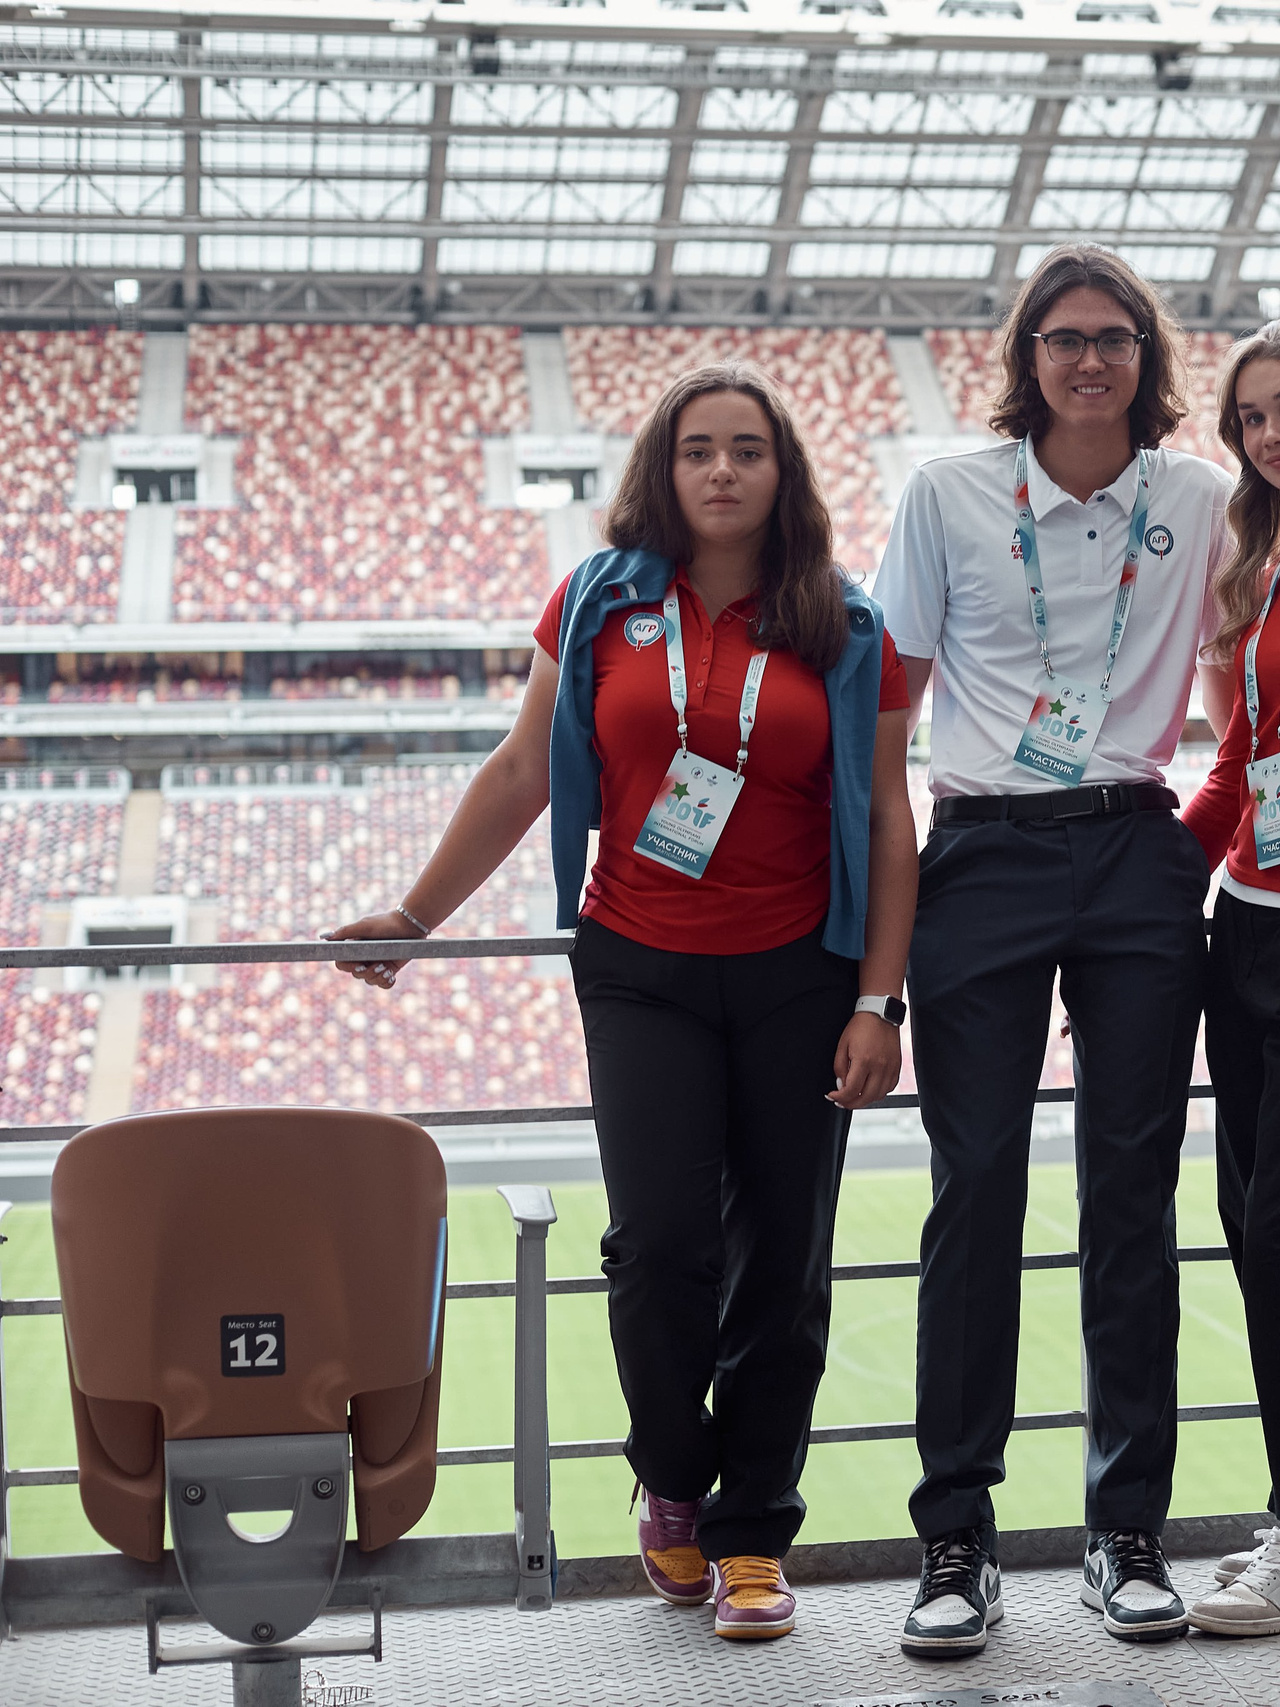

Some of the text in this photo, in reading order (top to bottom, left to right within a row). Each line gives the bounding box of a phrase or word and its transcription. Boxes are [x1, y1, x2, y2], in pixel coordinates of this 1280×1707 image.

[1023, 749, 1074, 775] УЧАСТНИК
[647, 833, 699, 864] УЧАСТНИК
[228, 1320, 277, 1329] Место Seat
[229, 1333, 278, 1367] 12
[980, 1690, 1060, 1704] Seat
